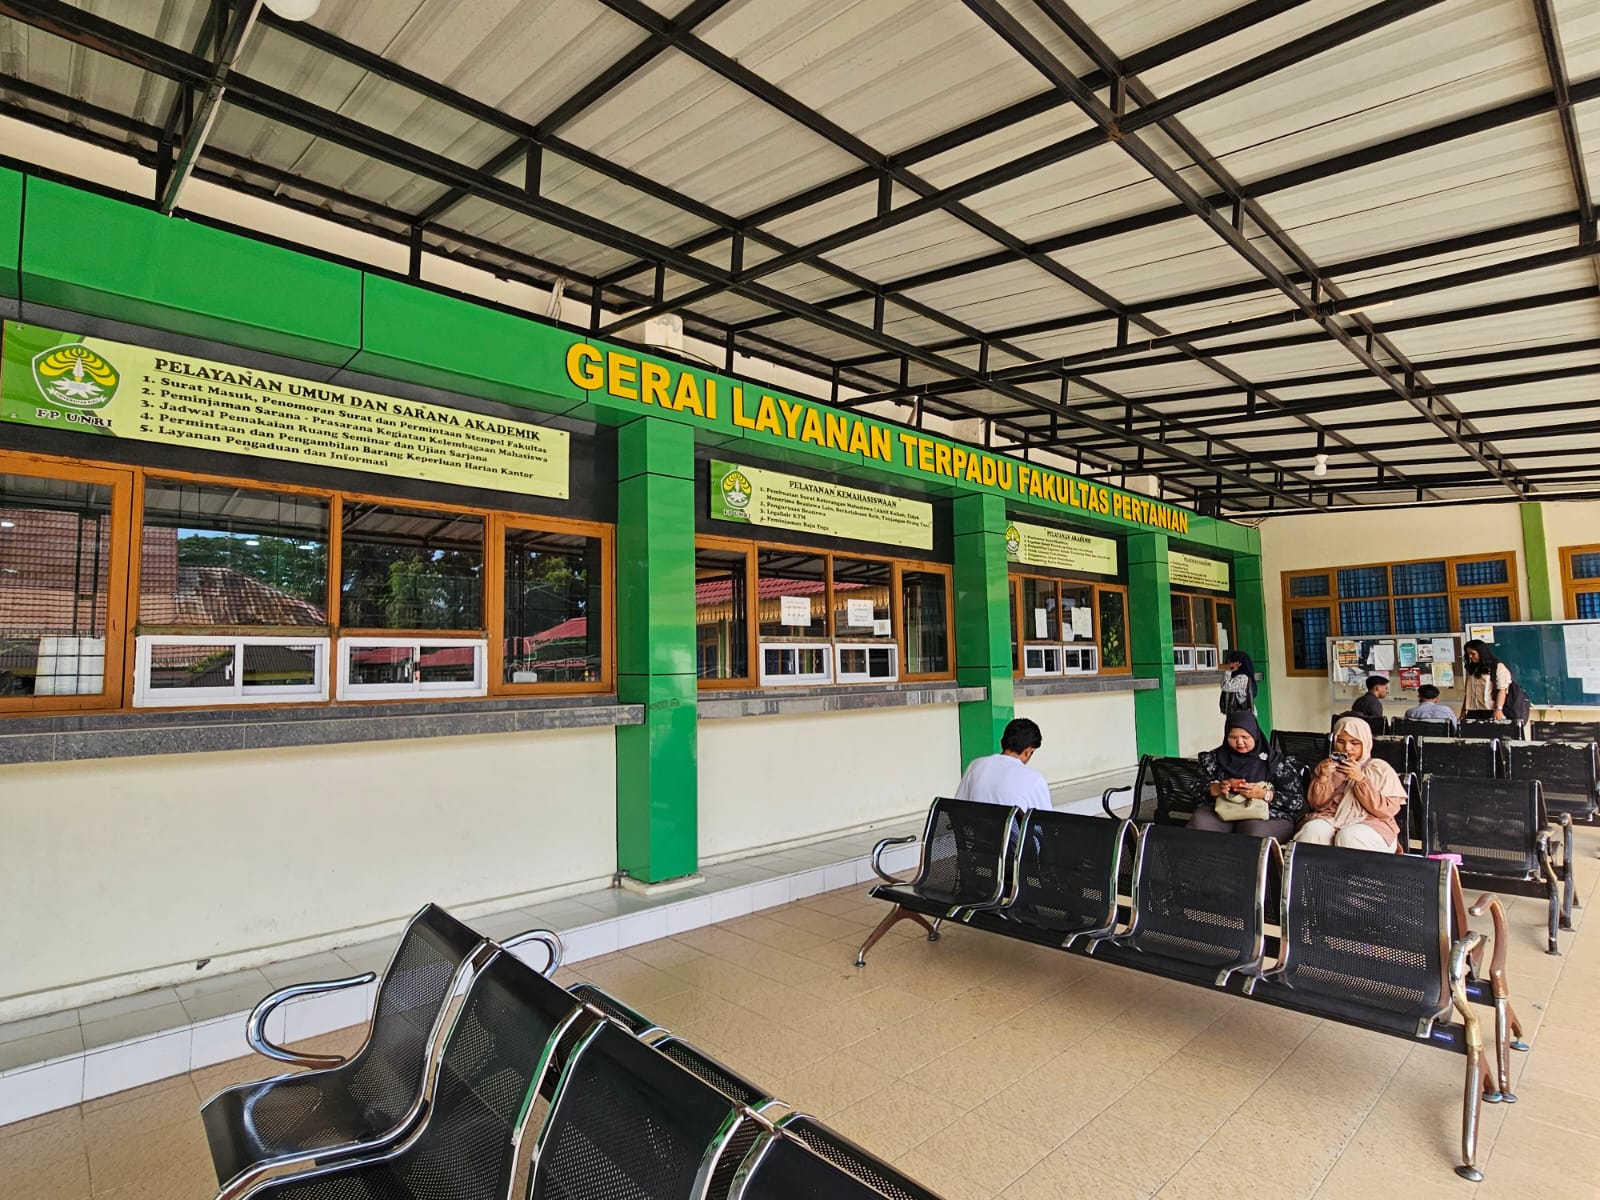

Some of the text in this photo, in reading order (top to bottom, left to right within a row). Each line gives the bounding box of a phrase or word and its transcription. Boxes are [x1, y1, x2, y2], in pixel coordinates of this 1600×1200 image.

[36, 408, 113, 427] FP UNRI
[140, 399, 488, 463] 3. Jadwal Pemakaian Ruang Seminar dan Ujian Sarjana
[141, 387, 155, 396] 2.
[161, 389, 250, 412] Peminjaman
[255, 406, 300, 421] Sarana
[312, 416, 373, 433] Prasarana
[376, 426, 427, 443] Kegiatan
[429, 436, 496, 455] Kelembagaan
[498, 446, 548, 463] Mahasiswa
[143, 375, 547, 454] 1. Surat Masuk, Penomoran Surat dan Permintaan Stempel Fakultas
[154, 358, 541, 441] PELAYANAN UMUM DAN SARANA AKADEMIK
[139, 424, 389, 467] 5. Layanan Pengaduan dan Informasi
[140, 412, 534, 480] 4. Permintaan dan Pengambilan Barang Keperluan Harian Kantor
[566, 343, 1188, 534] GERAI LAYANAN TERPADU FAKULTAS PERTANIAN
[789, 480, 897, 507] PELAYANAN KEMAHASISWAAN
